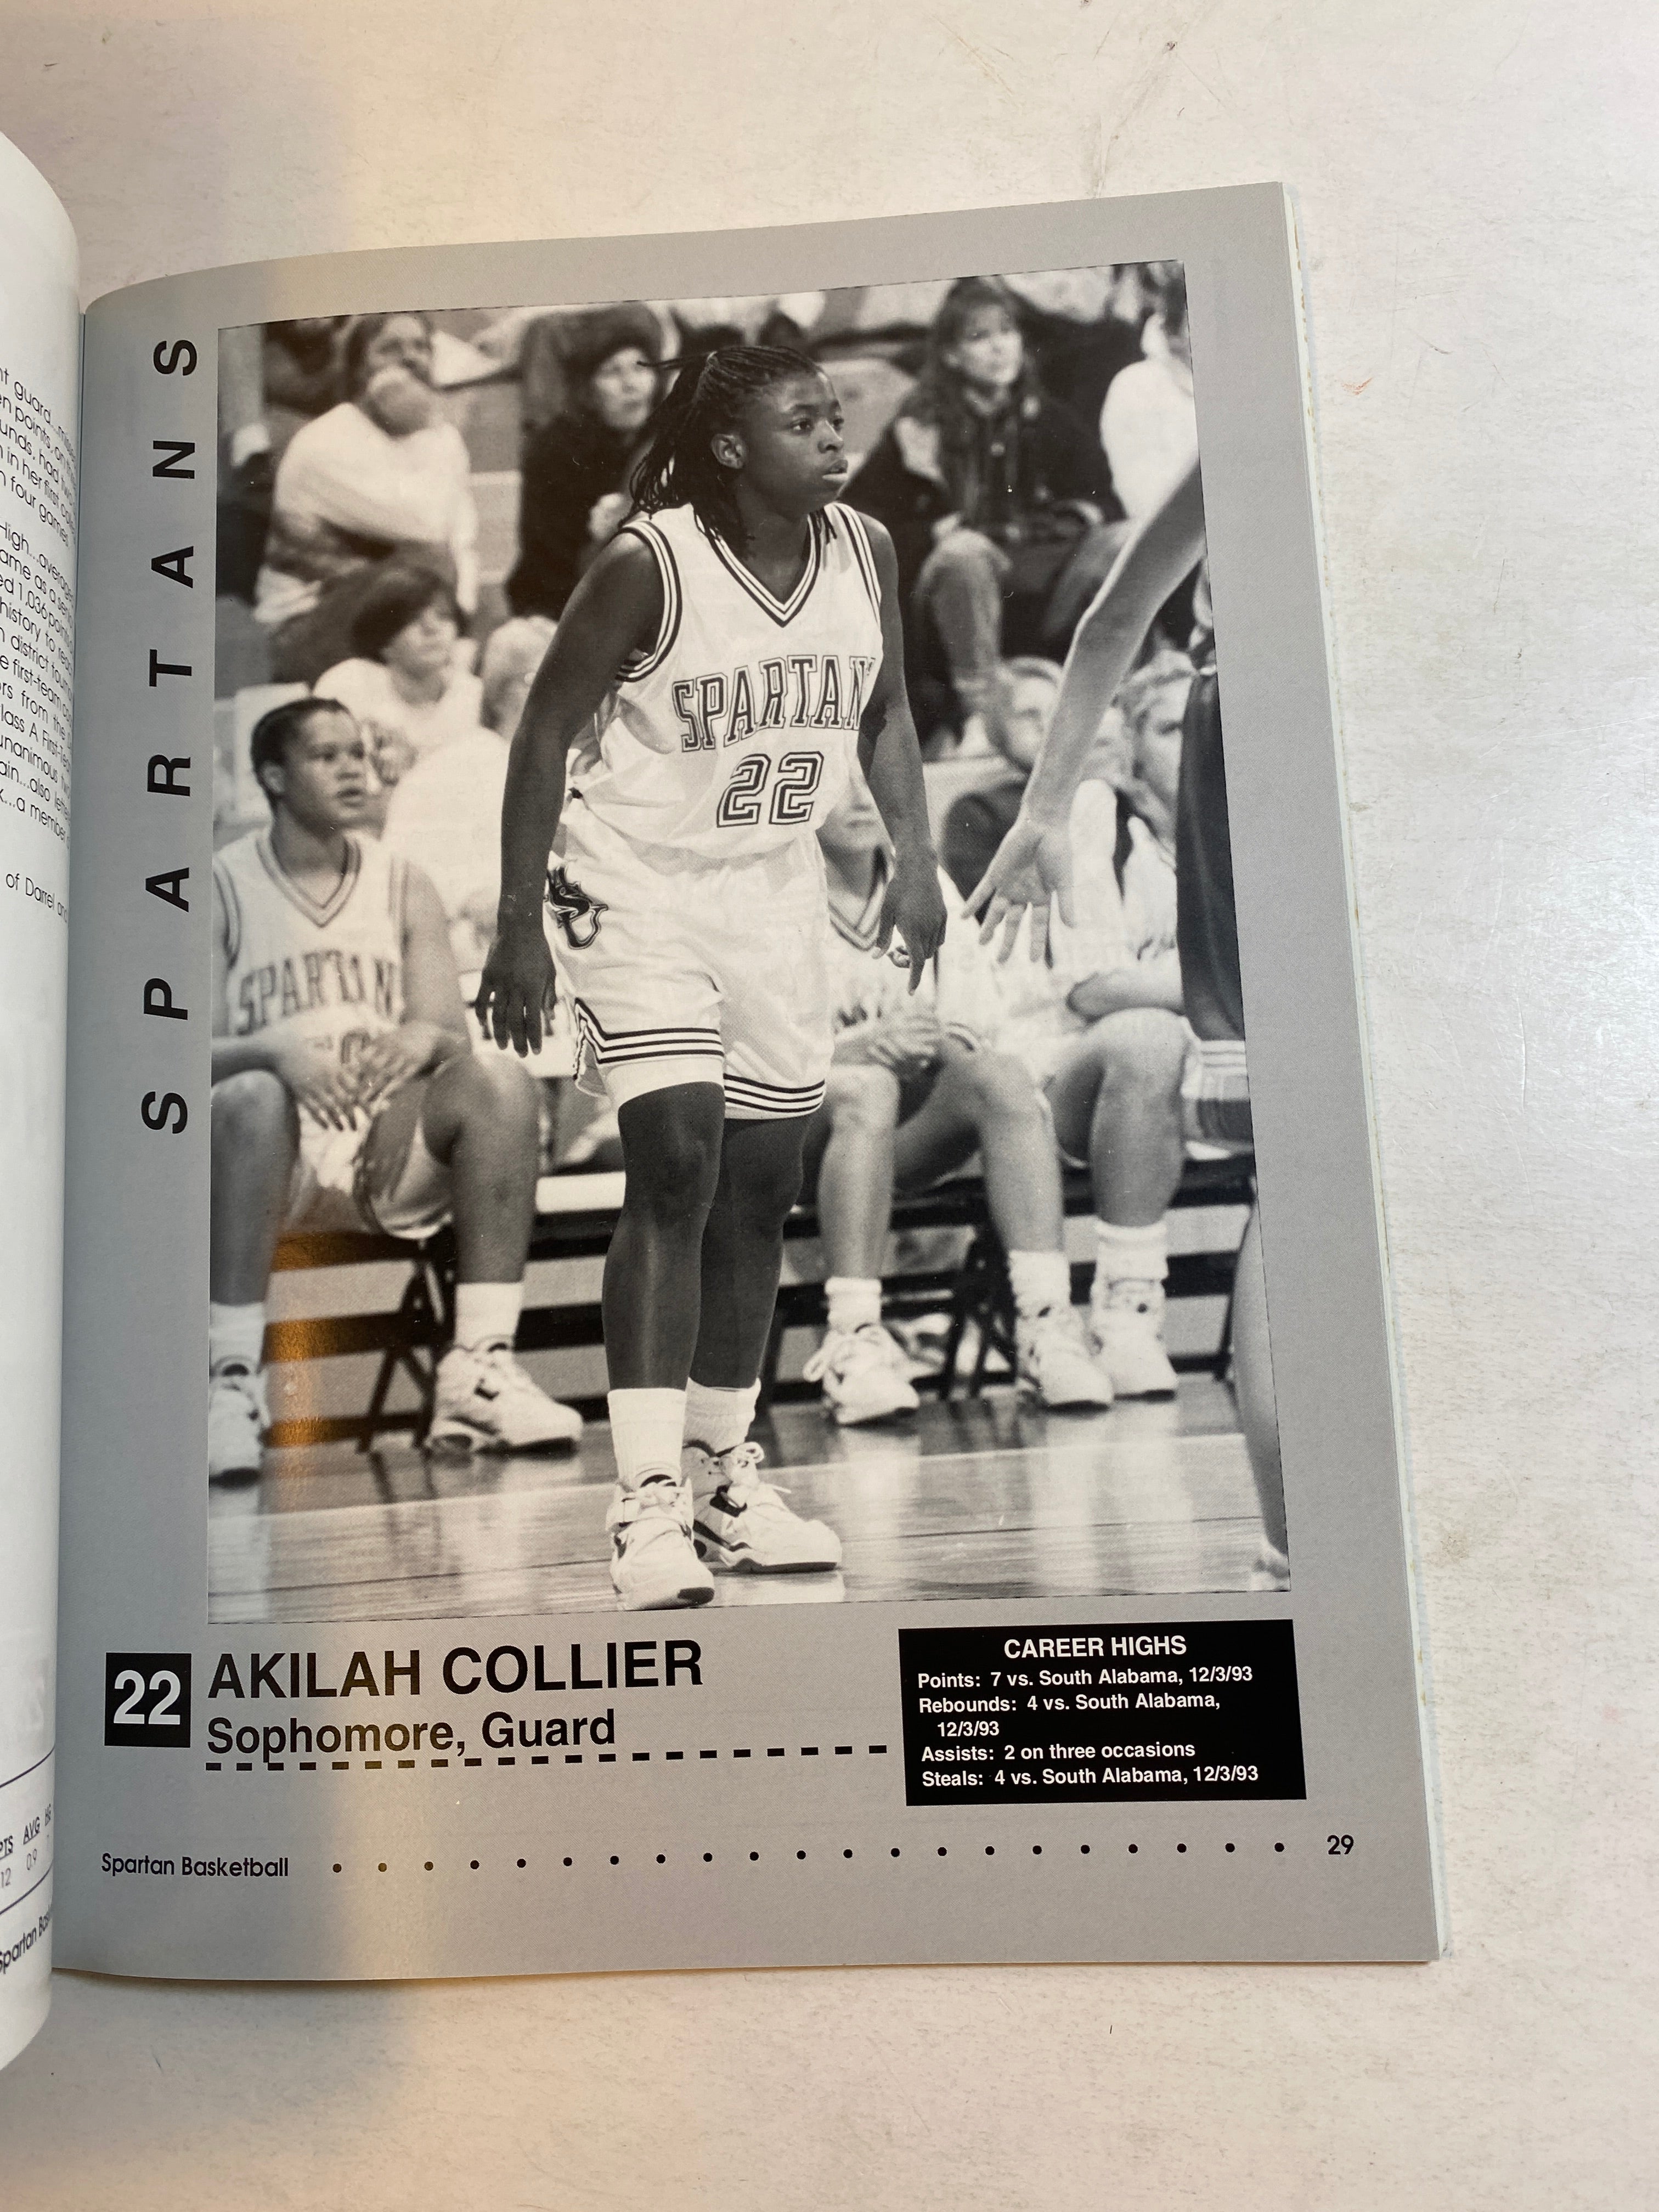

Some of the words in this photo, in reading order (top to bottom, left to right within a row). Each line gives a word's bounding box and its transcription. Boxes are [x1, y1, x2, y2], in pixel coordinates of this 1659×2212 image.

[7, 446, 19, 471] in
[22, 458, 42, 489] her
[39, 448, 59, 484] had
[11, 476, 37, 509] four
[19, 582, 48, 620] 1,036
[35, 574, 47, 595] as
[49, 588, 57, 605] a
[0, 596, 41, 642] history
[45, 629, 56, 652] to
[11, 634, 49, 673] district
[21, 690, 49, 724] from
[53, 714, 66, 741] the
[29, 722, 39, 742] A
[141, 339, 198, 1134] SPARTANS
[716, 751, 824, 828] 22
[30, 803, 66, 843] member
[5, 873, 20, 890] of
[1004, 1637, 1104, 1659] CAREER
[1111, 1635, 1187, 1656] HIGHS
[113, 1669, 181, 1725] 22
[207, 1649, 421, 1699] AKILAH
[442, 1639, 704, 1695] COLLIER
[917, 1671, 980, 1689] Points:
[990, 1672, 1000, 1687] 7
[1007, 1674, 1034, 1687] vs.
[1039, 1669, 1092, 1686] South
[1098, 1668, 1183, 1686] Alabama,
[1189, 1666, 1253, 1683] 12/3/93
[919, 1697, 1017, 1714] Rebounds:
[1027, 1696, 1037, 1712] 4
[1043, 1698, 1070, 1711] vs.
[1075, 1693, 1129, 1711] South
[1135, 1692, 1220, 1711] Alabama,
[207, 1717, 465, 1763] Sophomore,
[482, 1708, 615, 1748] Guard
[937, 1720, 1000, 1738] 12/3/93
[921, 1745, 995, 1762] Assists:
[1004, 1745, 1015, 1760] 2
[1021, 1747, 1043, 1760] on
[1048, 1743, 1096, 1760] three
[1101, 1741, 1196, 1759] occasions
[922, 1770, 984, 1787] Steals:
[994, 1769, 1006, 1785] 4
[1011, 1772, 1037, 1785] vs.
[1042, 1768, 1096, 1785] South
[1102, 1765, 1188, 1785] Alabama,
[1193, 1764, 1259, 1781] 12/3/93
[23, 1816, 41, 1844] AVG
[101, 1852, 174, 1877] Spartan
[182, 1856, 289, 1877] Basketball
[1327, 1834, 1354, 1855] 29
